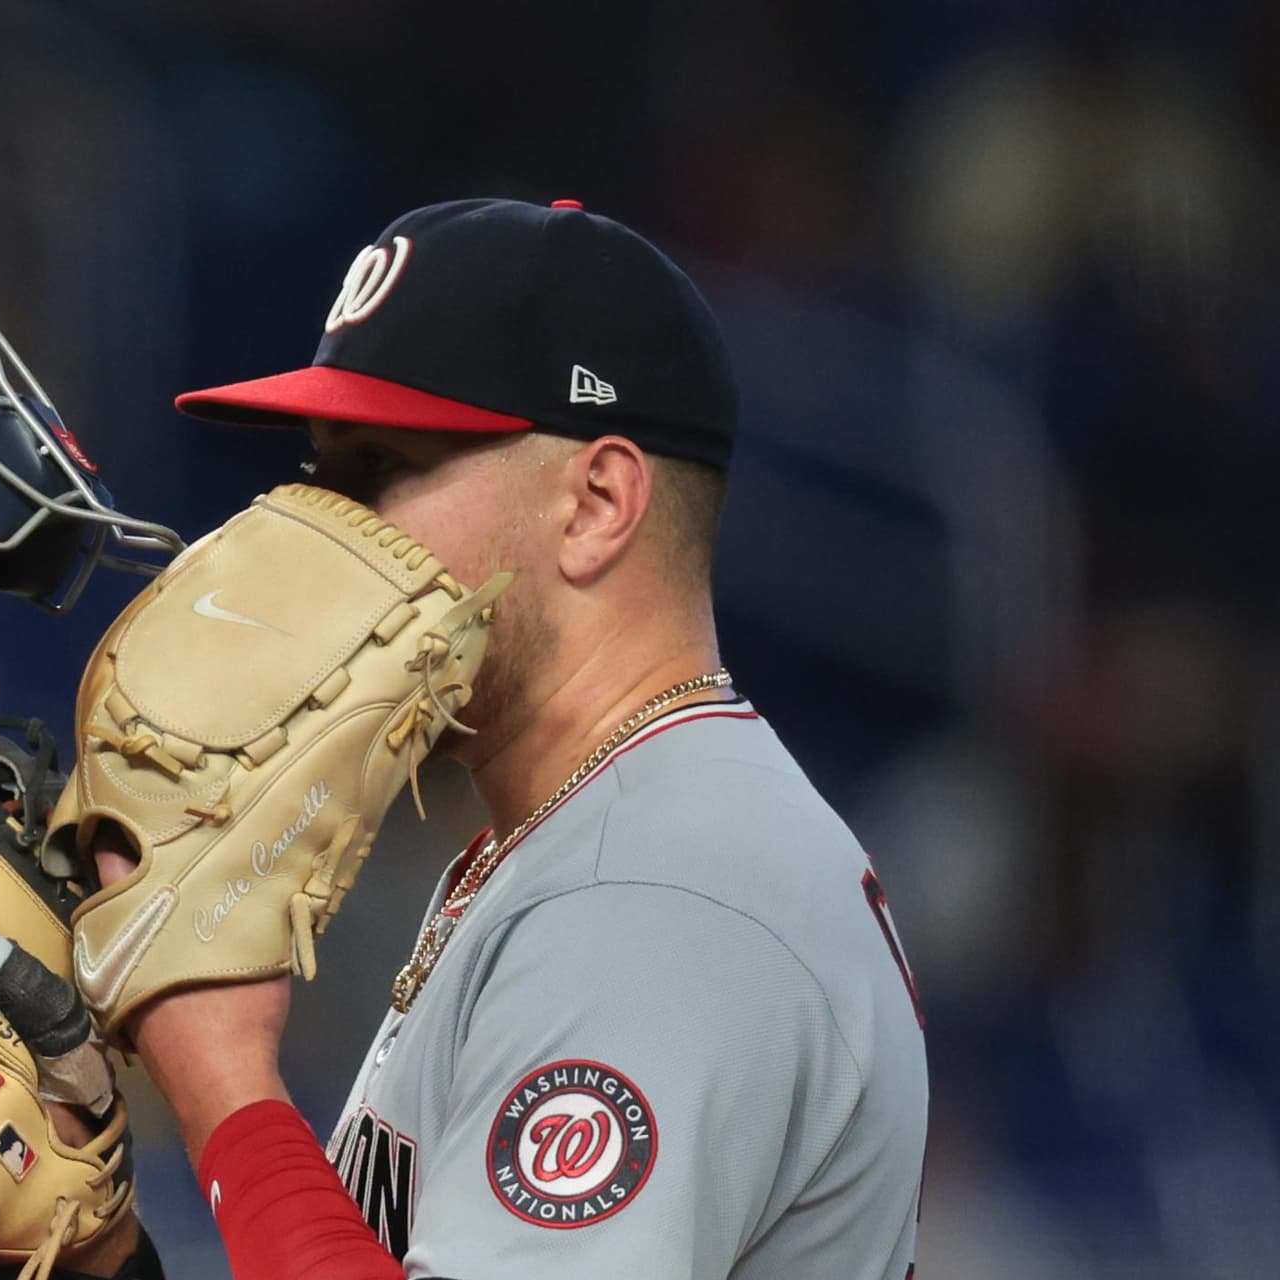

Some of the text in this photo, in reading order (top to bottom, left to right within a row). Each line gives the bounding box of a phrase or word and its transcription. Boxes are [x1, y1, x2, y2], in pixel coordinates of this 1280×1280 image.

[193, 879, 251, 942] Cade
[504, 1066, 649, 1143] WASHINGTON
[530, 1110, 612, 1183] W
[496, 1164, 627, 1221] NATIONALS
